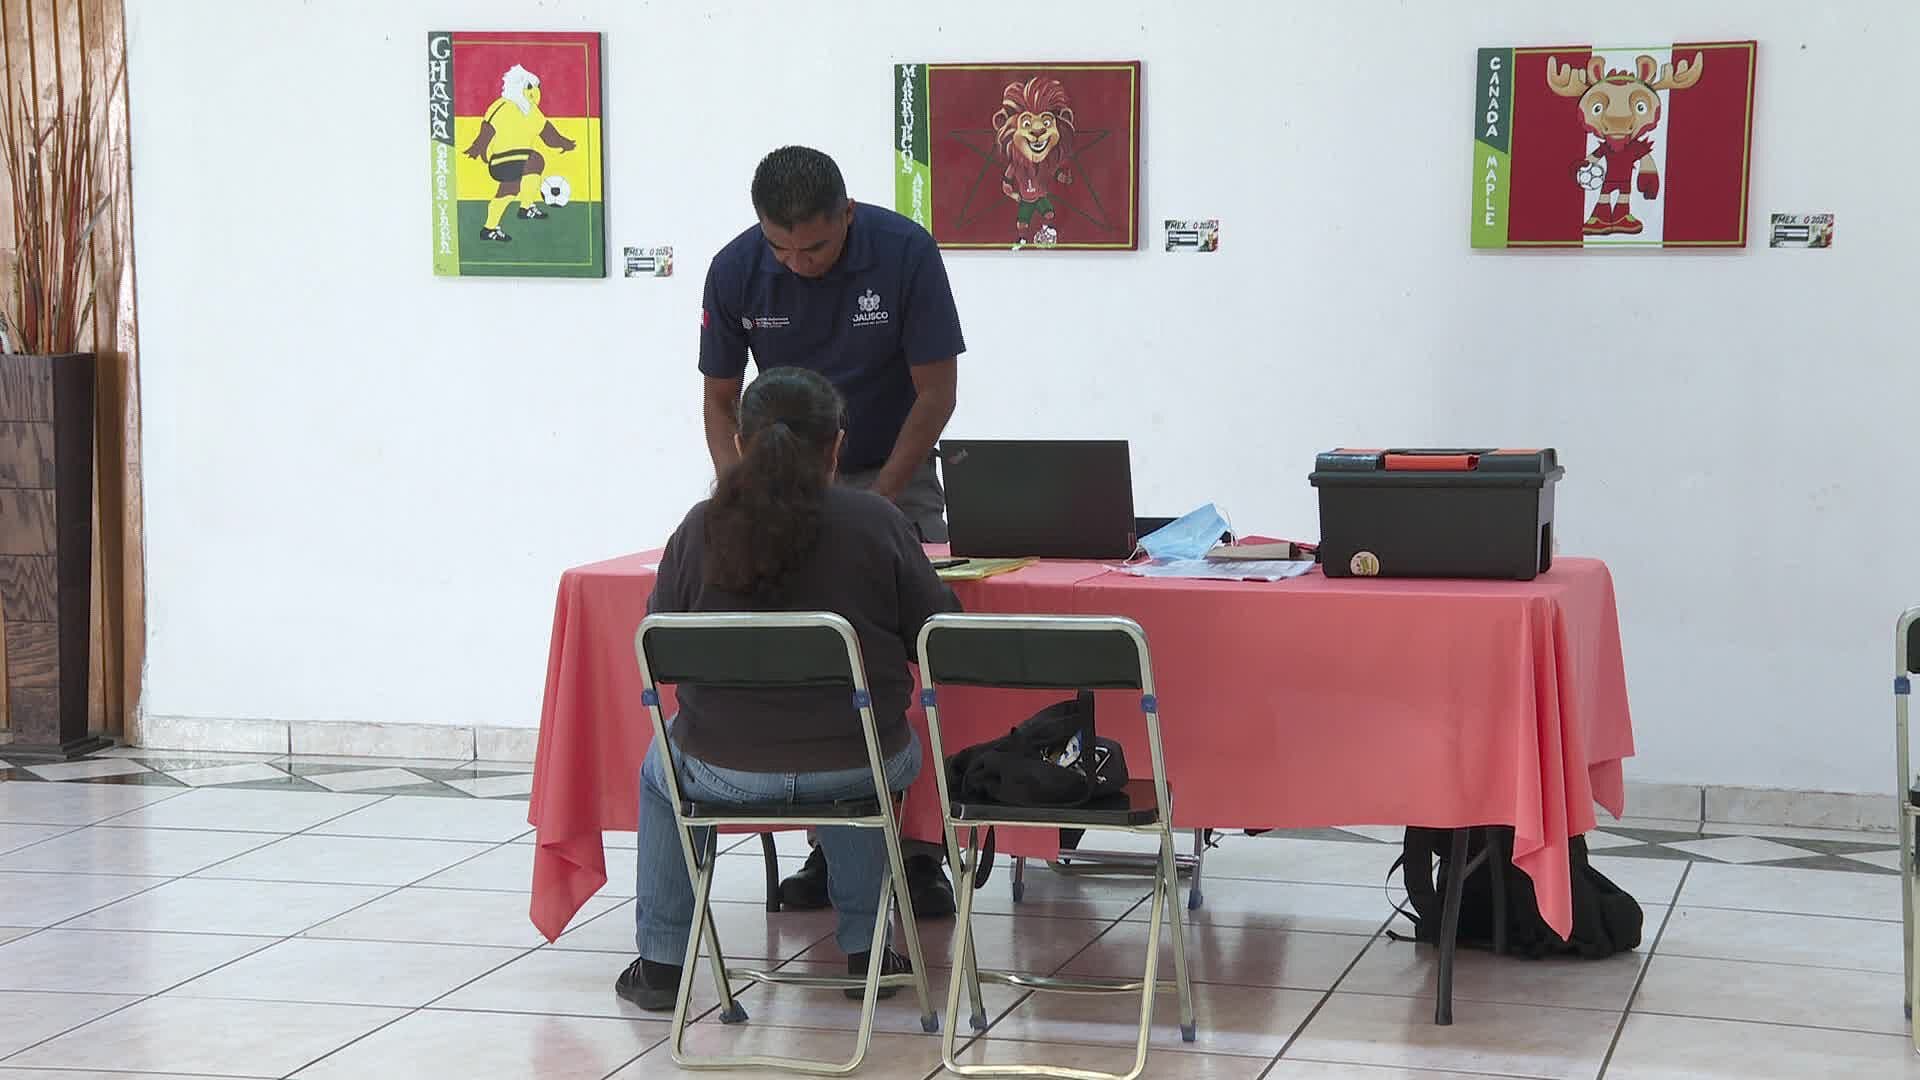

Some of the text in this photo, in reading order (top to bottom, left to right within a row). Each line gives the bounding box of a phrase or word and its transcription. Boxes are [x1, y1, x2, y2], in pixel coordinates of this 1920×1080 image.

[430, 36, 451, 139] GHANA
[901, 64, 917, 175] MARRUECOS
[1486, 56, 1501, 137] CANADA
[1485, 155, 1499, 225] MAPLE
[852, 311, 888, 322] JALISCO
